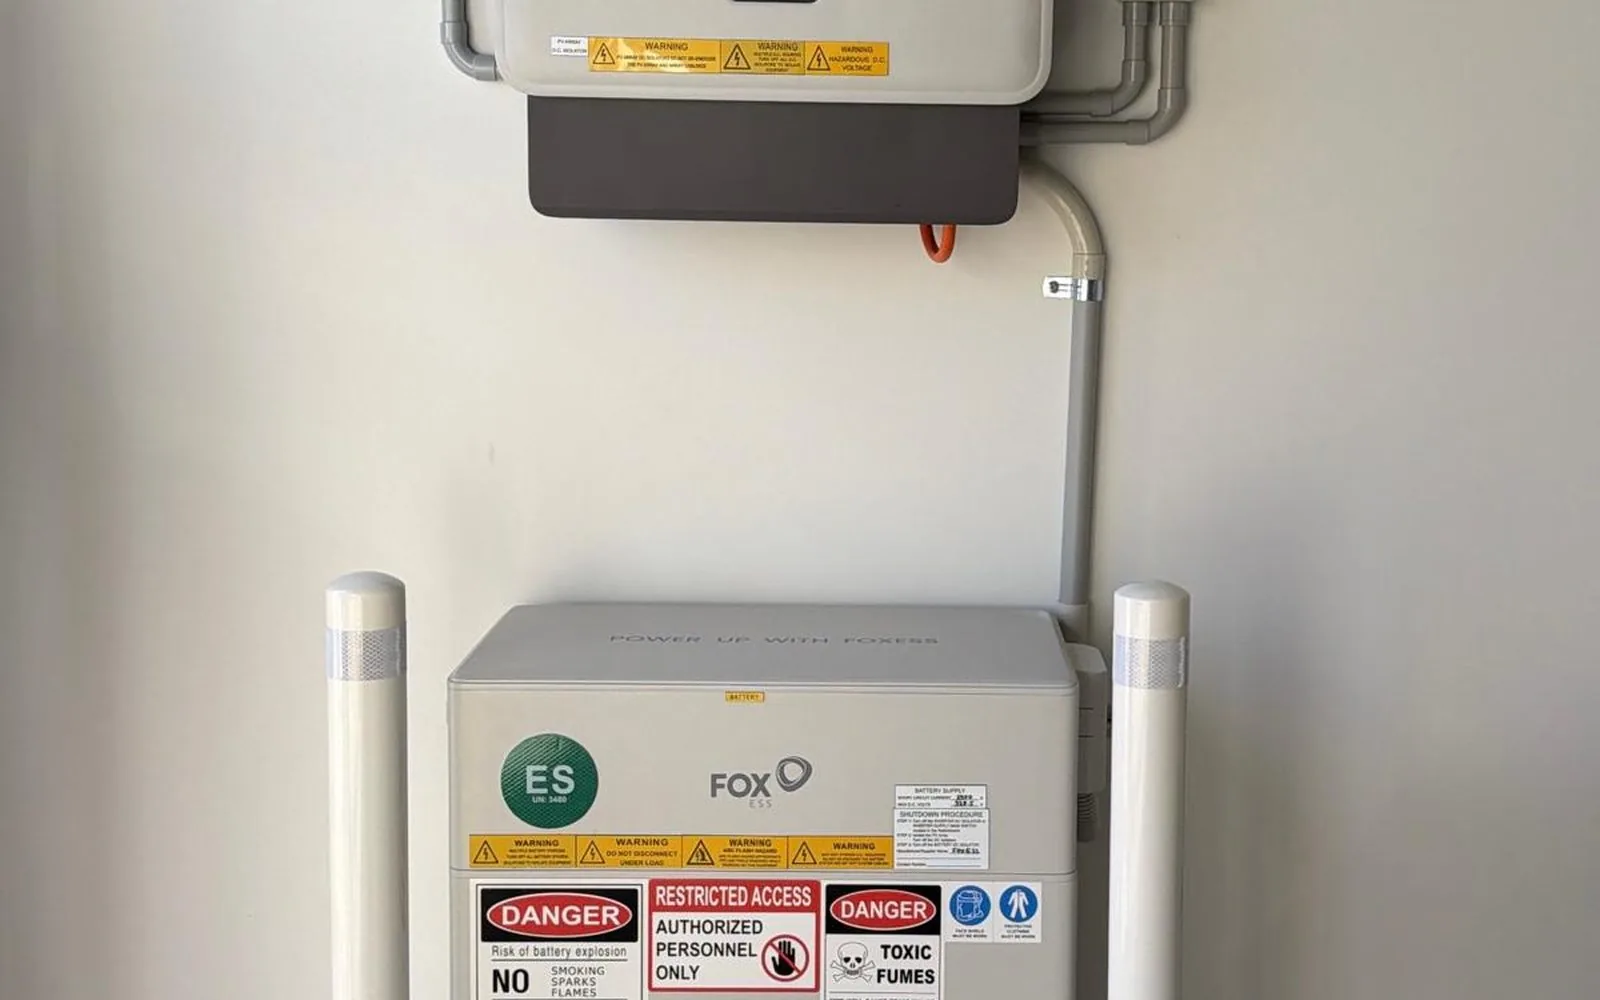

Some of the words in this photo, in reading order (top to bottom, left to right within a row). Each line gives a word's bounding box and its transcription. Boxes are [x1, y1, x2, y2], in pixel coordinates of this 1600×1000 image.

[644, 42, 689, 51] WARNING
[756, 42, 799, 51] WARNING
[840, 46, 874, 54] WARNING
[828, 56, 870, 64] HAZARDOUS
[872, 56, 886, 64] D.C.
[610, 634, 702, 644] POWER
[716, 635, 751, 645] UP
[764, 636, 829, 645] WITH
[844, 637, 940, 646] FOXESS
[526, 764, 576, 795] ES
[710, 772, 772, 798] FOX
[532, 796, 546, 804] UN:
[748, 800, 772, 808] ESS
[616, 838, 669, 846] WARNING
[728, 838, 772, 848] WARNING
[656, 886, 748, 907] RESTRICTED
[752, 886, 812, 907] ACCESS
[502, 905, 621, 926] DANGER
[840, 901, 928, 920] DANGER
[656, 919, 764, 935] AUTHORIZED
[492, 945, 516, 957] Risk
[519, 945, 530, 957] of
[533, 945, 571, 959] battery
[576, 945, 627, 959] explosion
[656, 942, 758, 957] PERSONNEL
[880, 944, 932, 960] TOXIC
[551, 966, 605, 976] SMOKING
[656, 965, 700, 980] ONLY
[877, 969, 935, 984] FUMES
[492, 968, 530, 994] NO
[551, 976, 596, 986] SPARKS
[551, 988, 597, 997] FLAMES
